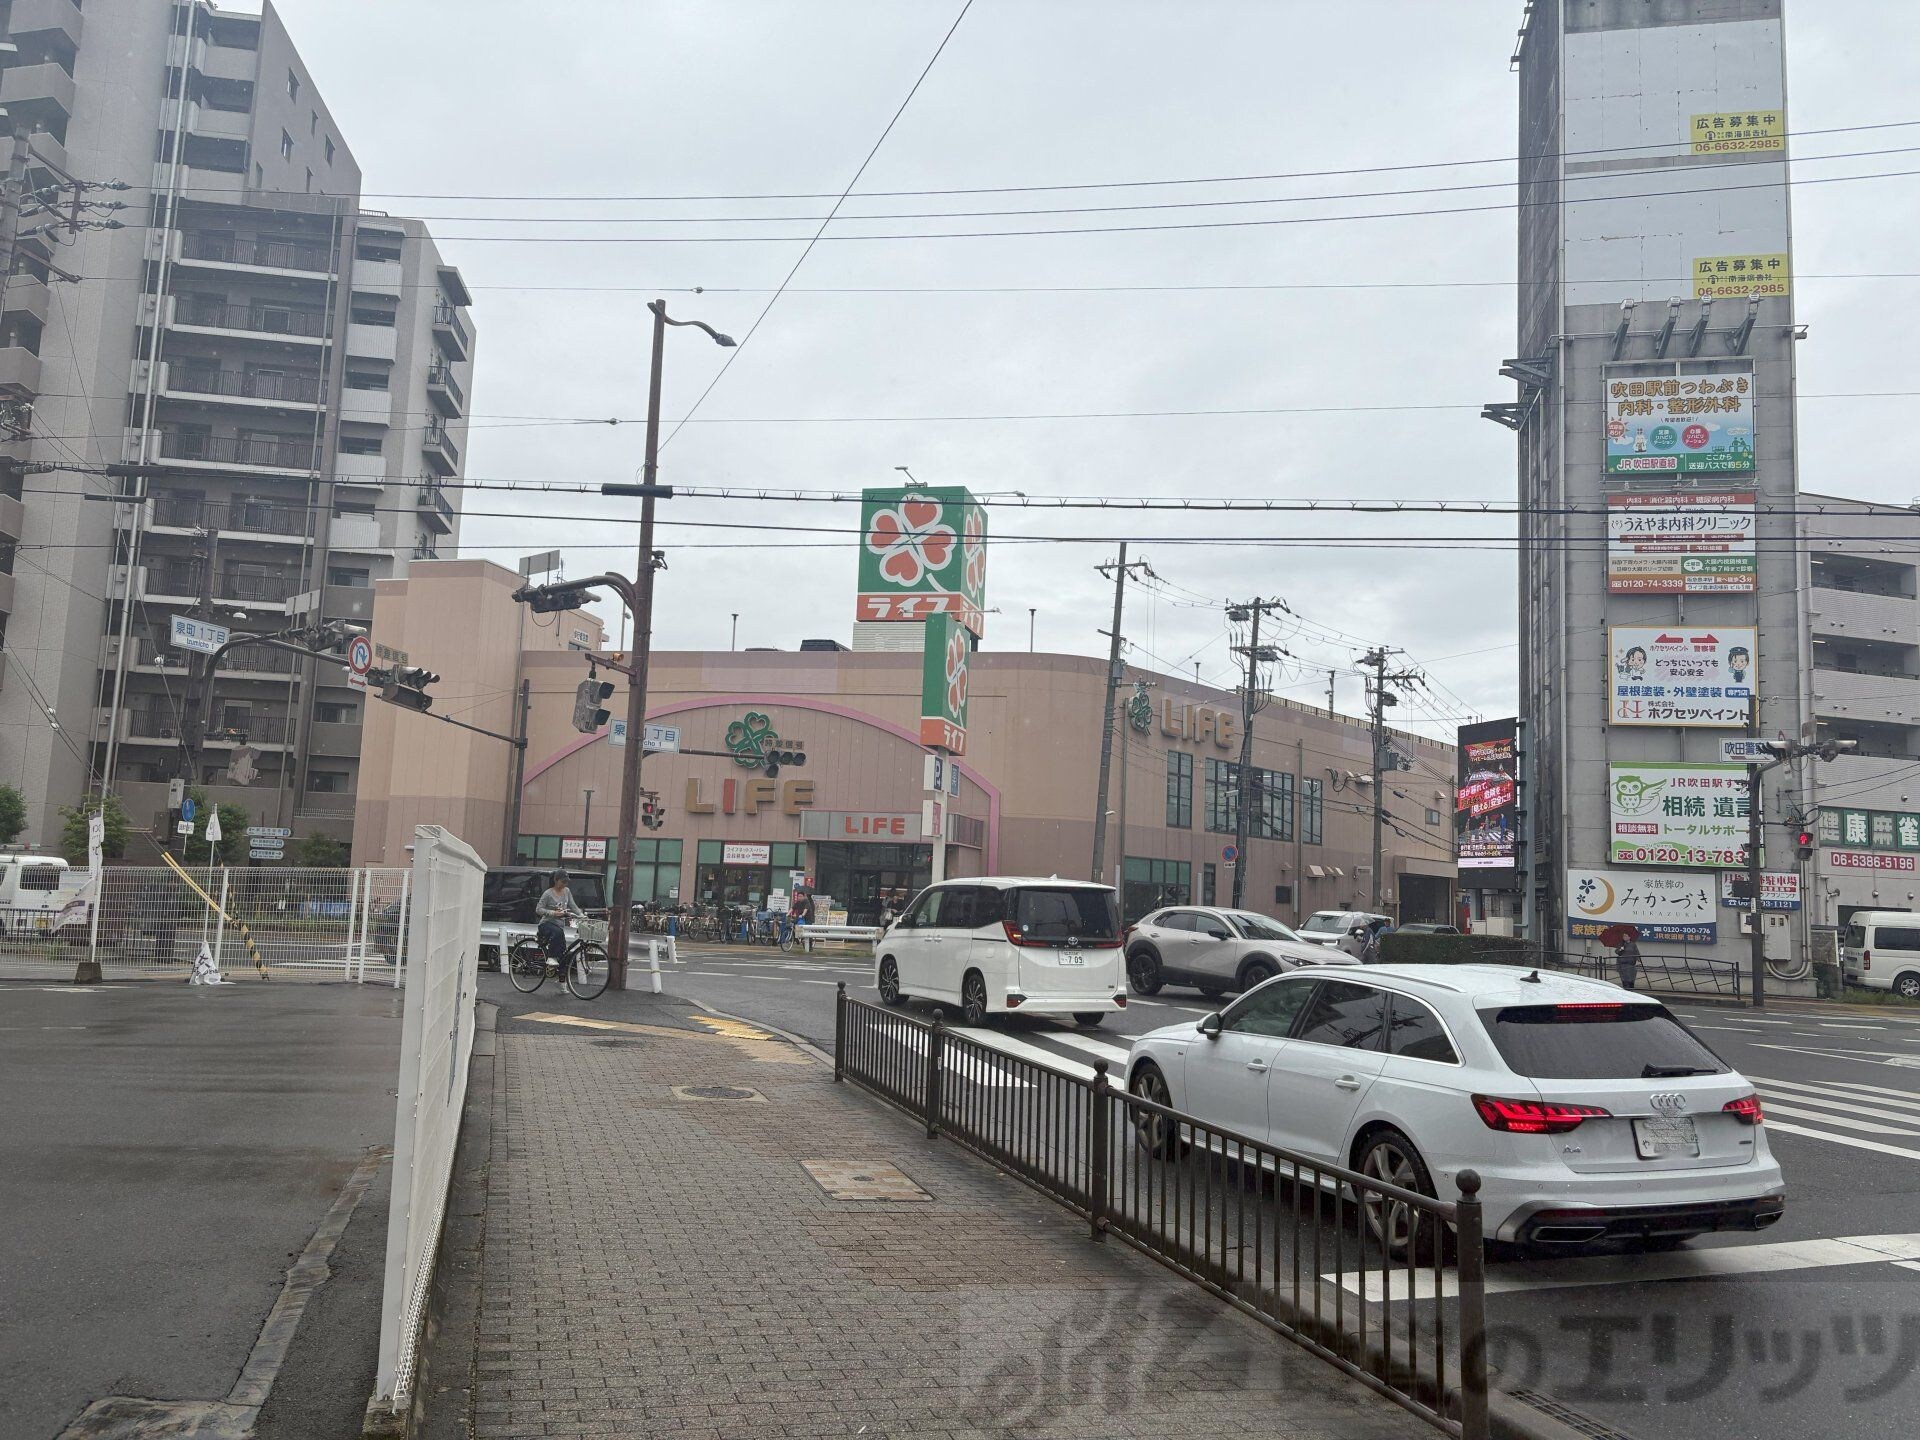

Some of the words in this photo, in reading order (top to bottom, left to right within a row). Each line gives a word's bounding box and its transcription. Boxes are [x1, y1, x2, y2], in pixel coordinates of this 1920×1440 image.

[1697, 115, 1776, 129] 広告募集中
[1695, 140, 1780, 152] 06-6632-2985
[1699, 258, 1780, 273] 広告募集中
[1697, 284, 1785, 296] 06-6632-2985
[1611, 377, 1749, 398] 吹田駅前つわぶき
[1617, 396, 1742, 416] 内科・整形外科
[1688, 461, 1751, 470] 送迎バスで約5分
[1625, 516, 1751, 531] うえやま内科クリニック
[1622, 579, 1684, 588] 0120-74-3339
[867, 597, 950, 618] ライフ
[176, 621, 226, 644] 泉町1丁目
[1655, 659, 1719, 668] どっちにいっても
[1669, 669, 1705, 677] 安心安全
[1617, 686, 1722, 698] 屋根塗装・外壁塗装
[1648, 708, 1750, 721] ホクセツペイント
[1161, 698, 1234, 749] LIFE
[943, 724, 965, 752] ライフ
[686, 777, 815, 815] LIFE
[1662, 796, 1706, 818] 相続
[845, 816, 906, 835] LIFE
[1617, 823, 1657, 834] 相談無料
[1819, 810, 1919, 845] 健康麻雀
[1832, 853, 1914, 870] 06-6386-5196
[1620, 888, 1708, 910] みかづき
[1662, 926, 1711, 934] 0120-300-776
